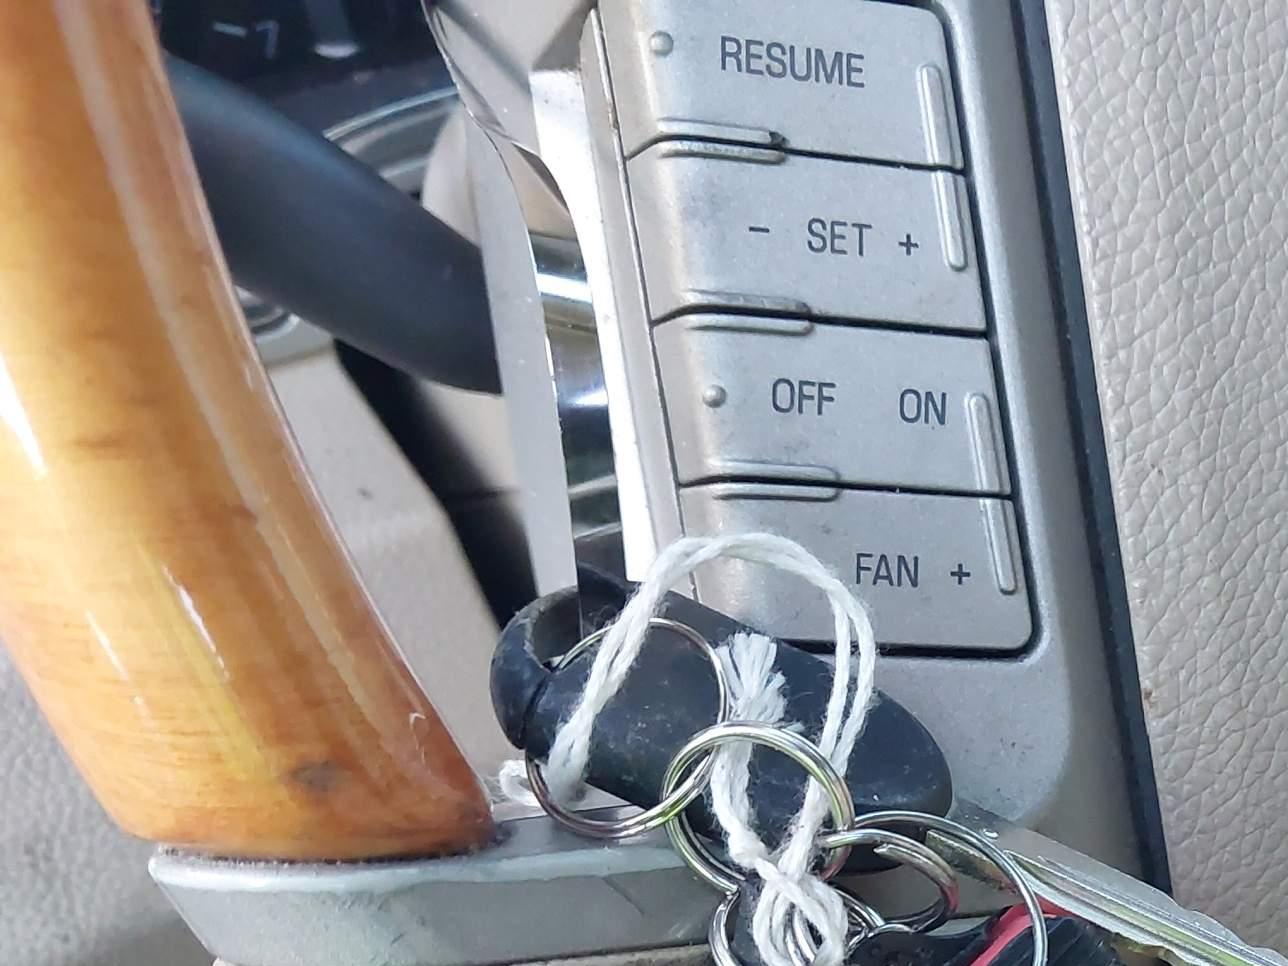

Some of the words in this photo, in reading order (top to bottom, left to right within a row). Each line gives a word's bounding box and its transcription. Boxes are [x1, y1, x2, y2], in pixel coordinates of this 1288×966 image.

[720, 35, 865, 88] RESUME
[807, 217, 873, 256] SET
[772, 378, 837, 416] OFF
[899, 388, 947, 426] ON
[855, 553, 919, 588] FAN
